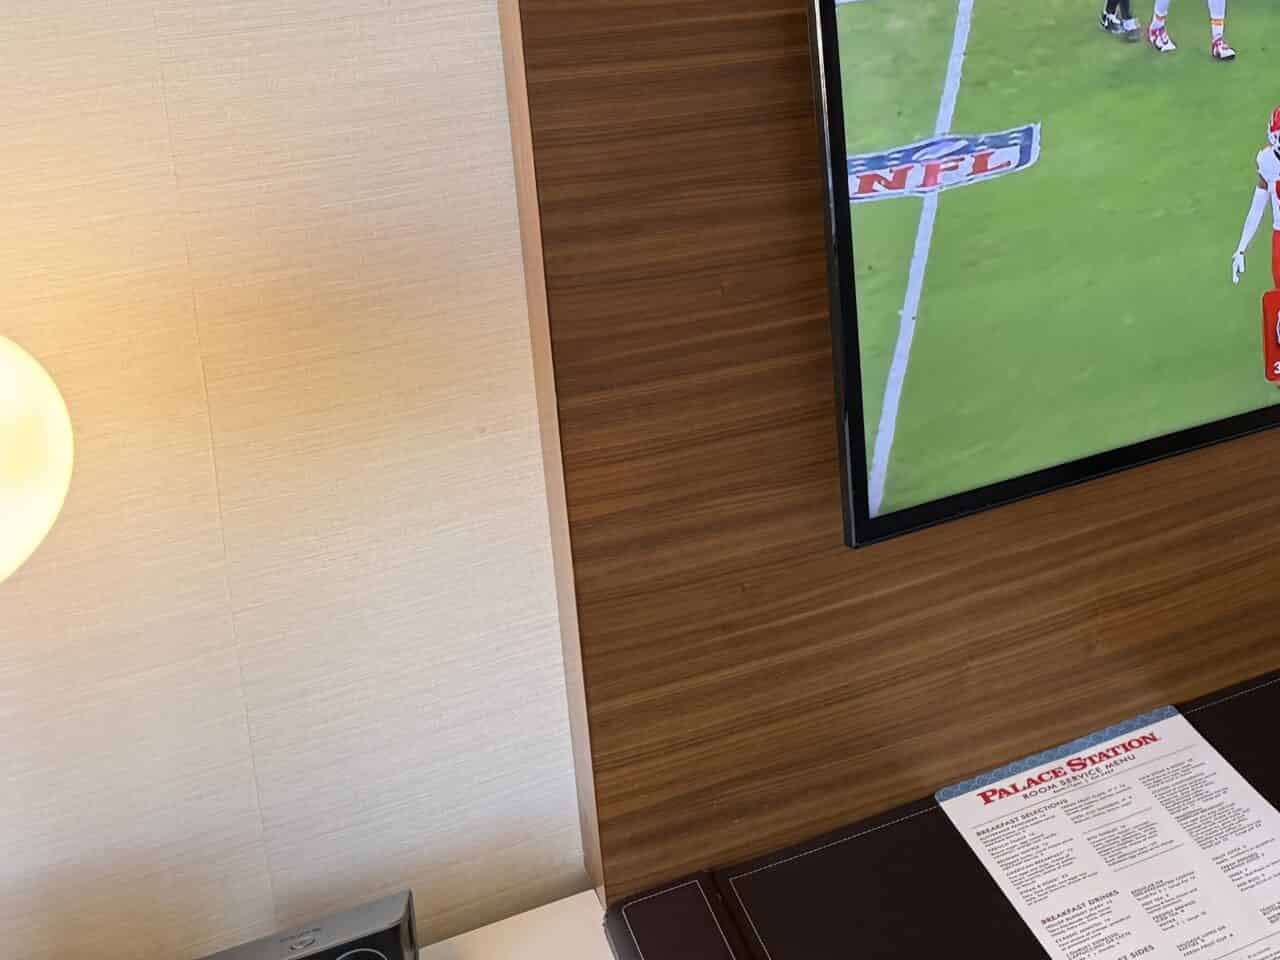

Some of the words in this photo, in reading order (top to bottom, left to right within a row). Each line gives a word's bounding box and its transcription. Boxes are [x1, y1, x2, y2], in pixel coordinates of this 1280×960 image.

[855, 150, 1012, 195] NFL
[977, 767, 1068, 805] PALACE
[1066, 733, 1160, 772] STATION
[1023, 783, 1058, 799] ROOM
[1060, 767, 1101, 788] SERVICE
[1105, 754, 1136, 770] MENU
[976, 817, 1019, 837] BREAKFAST
[1041, 902, 1087, 925] BREAKFAST
